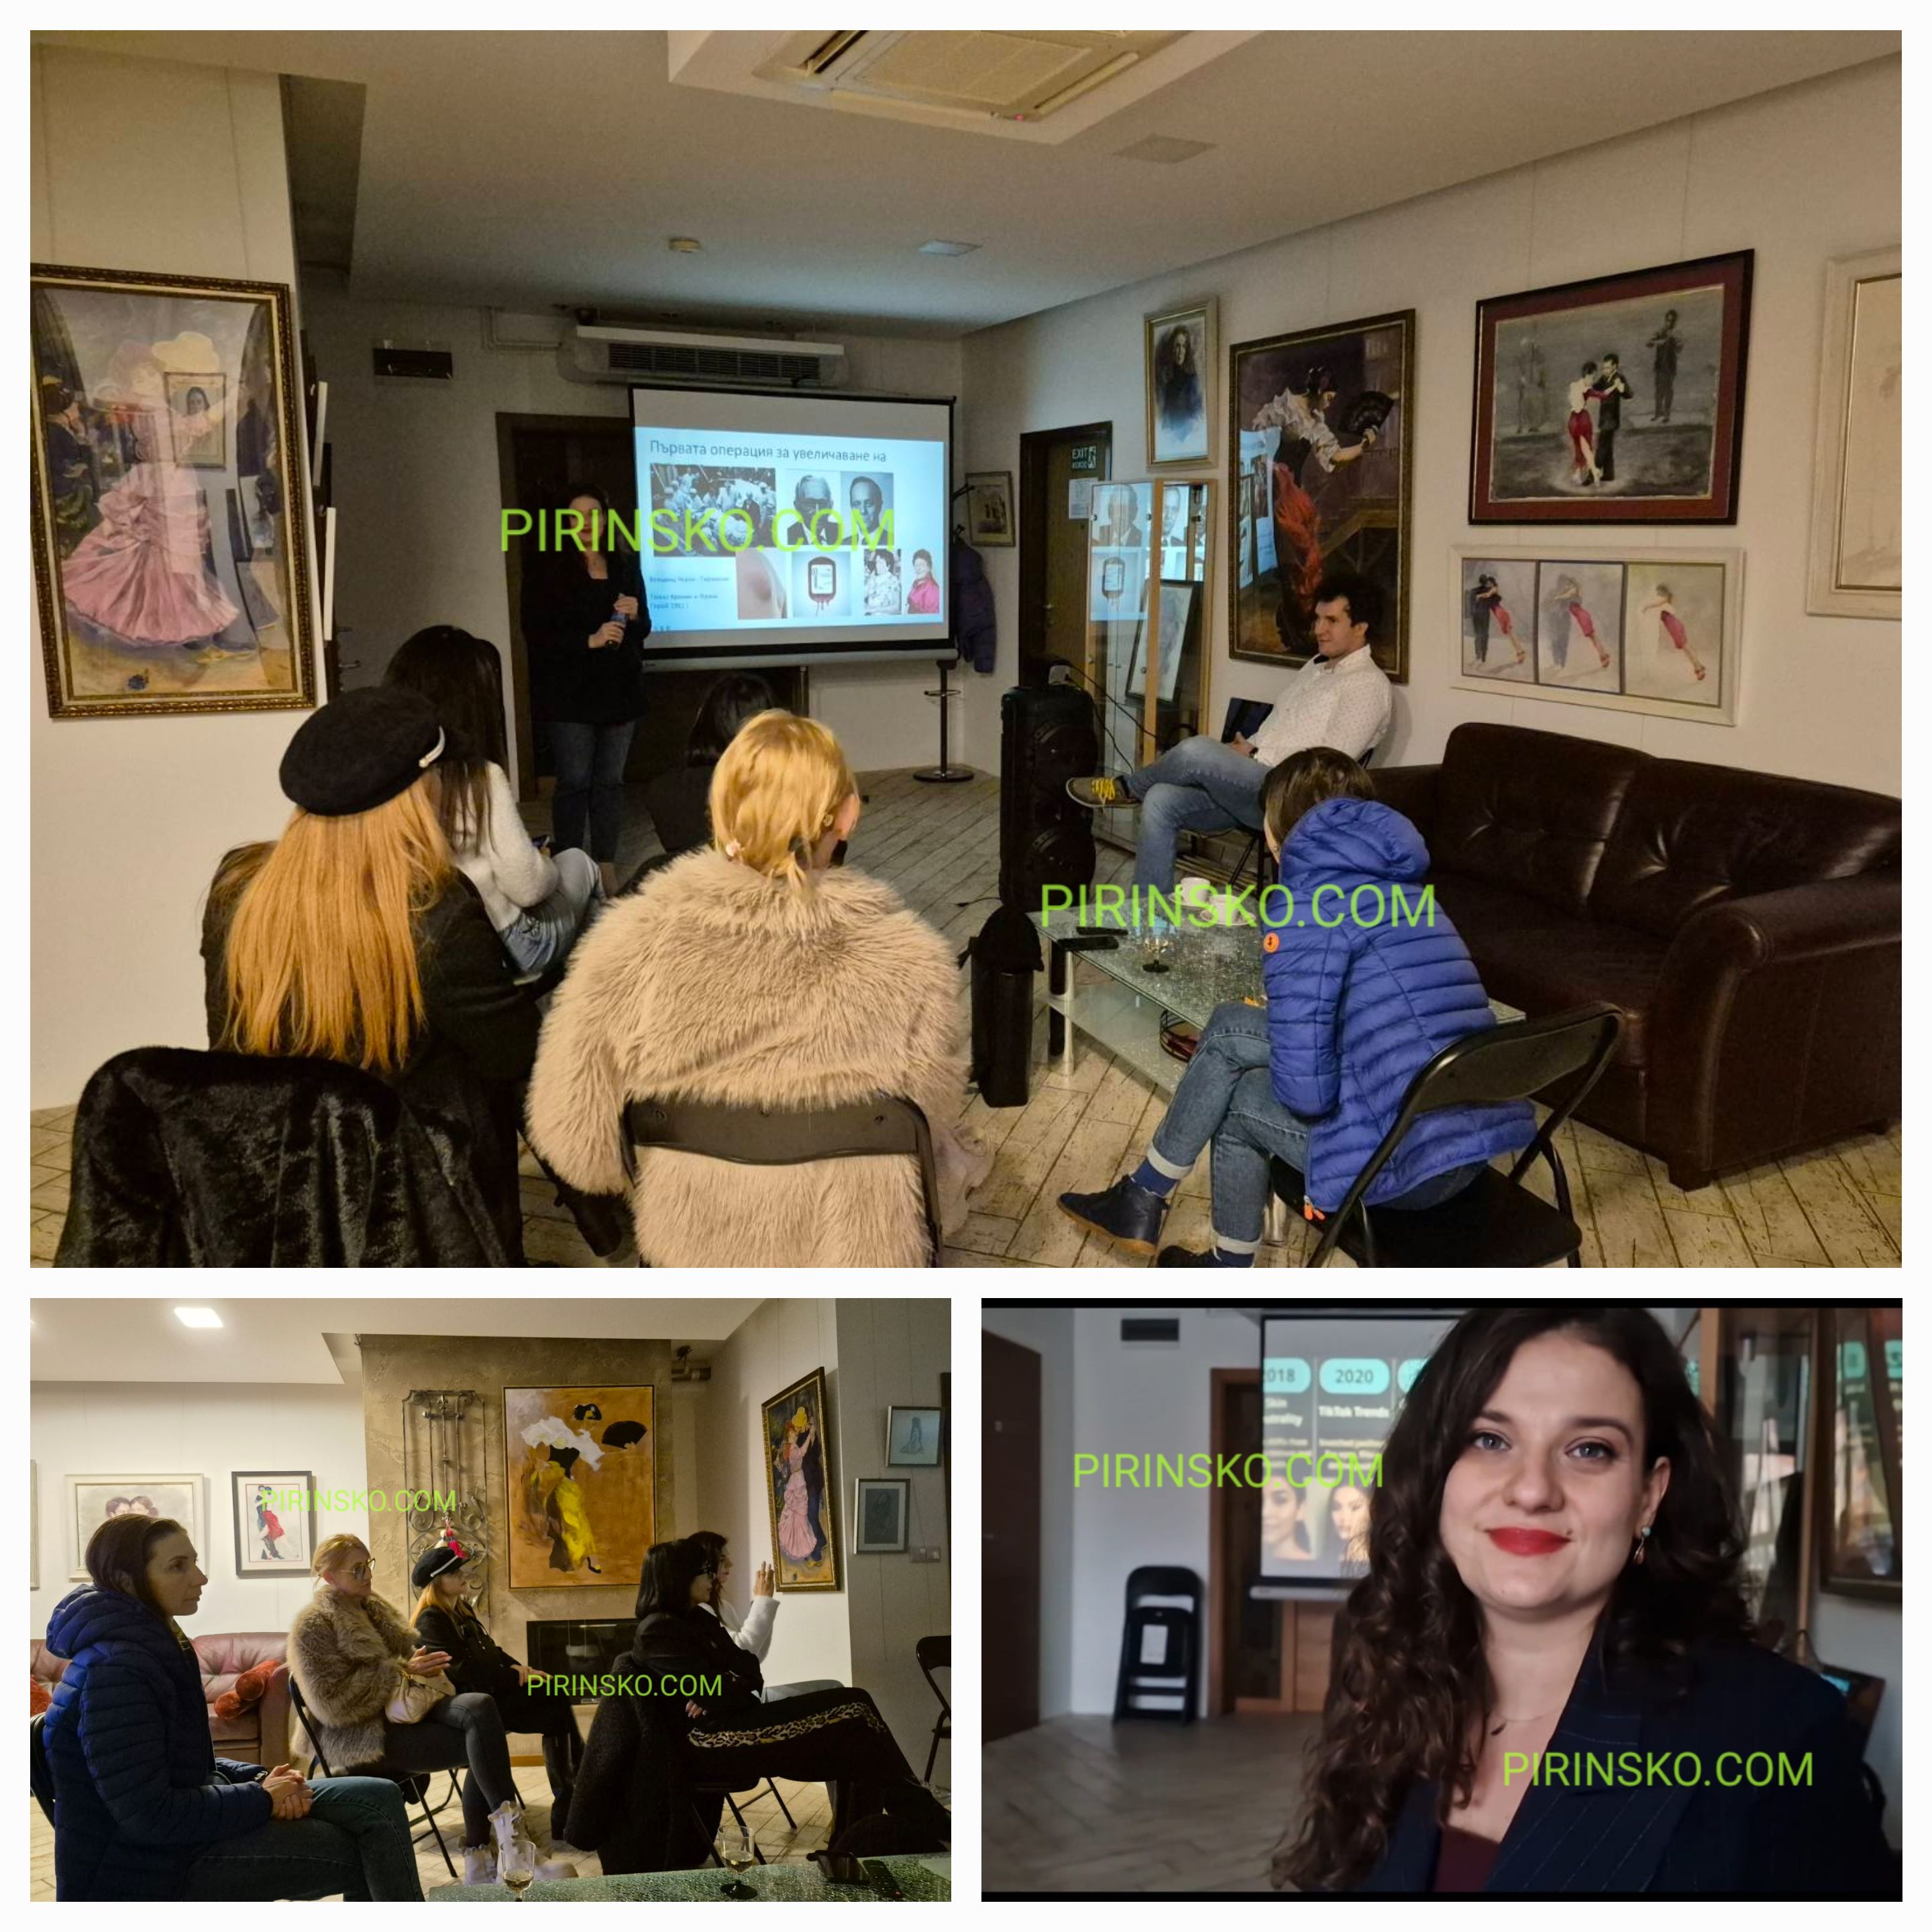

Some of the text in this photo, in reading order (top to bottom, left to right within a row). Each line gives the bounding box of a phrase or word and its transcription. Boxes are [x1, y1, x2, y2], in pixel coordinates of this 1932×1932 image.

[649, 439, 887, 462] Първата операция за увеличаване на
[1072, 447, 1088, 459] EXIT
[1335, 1369, 1374, 1384] 2020
